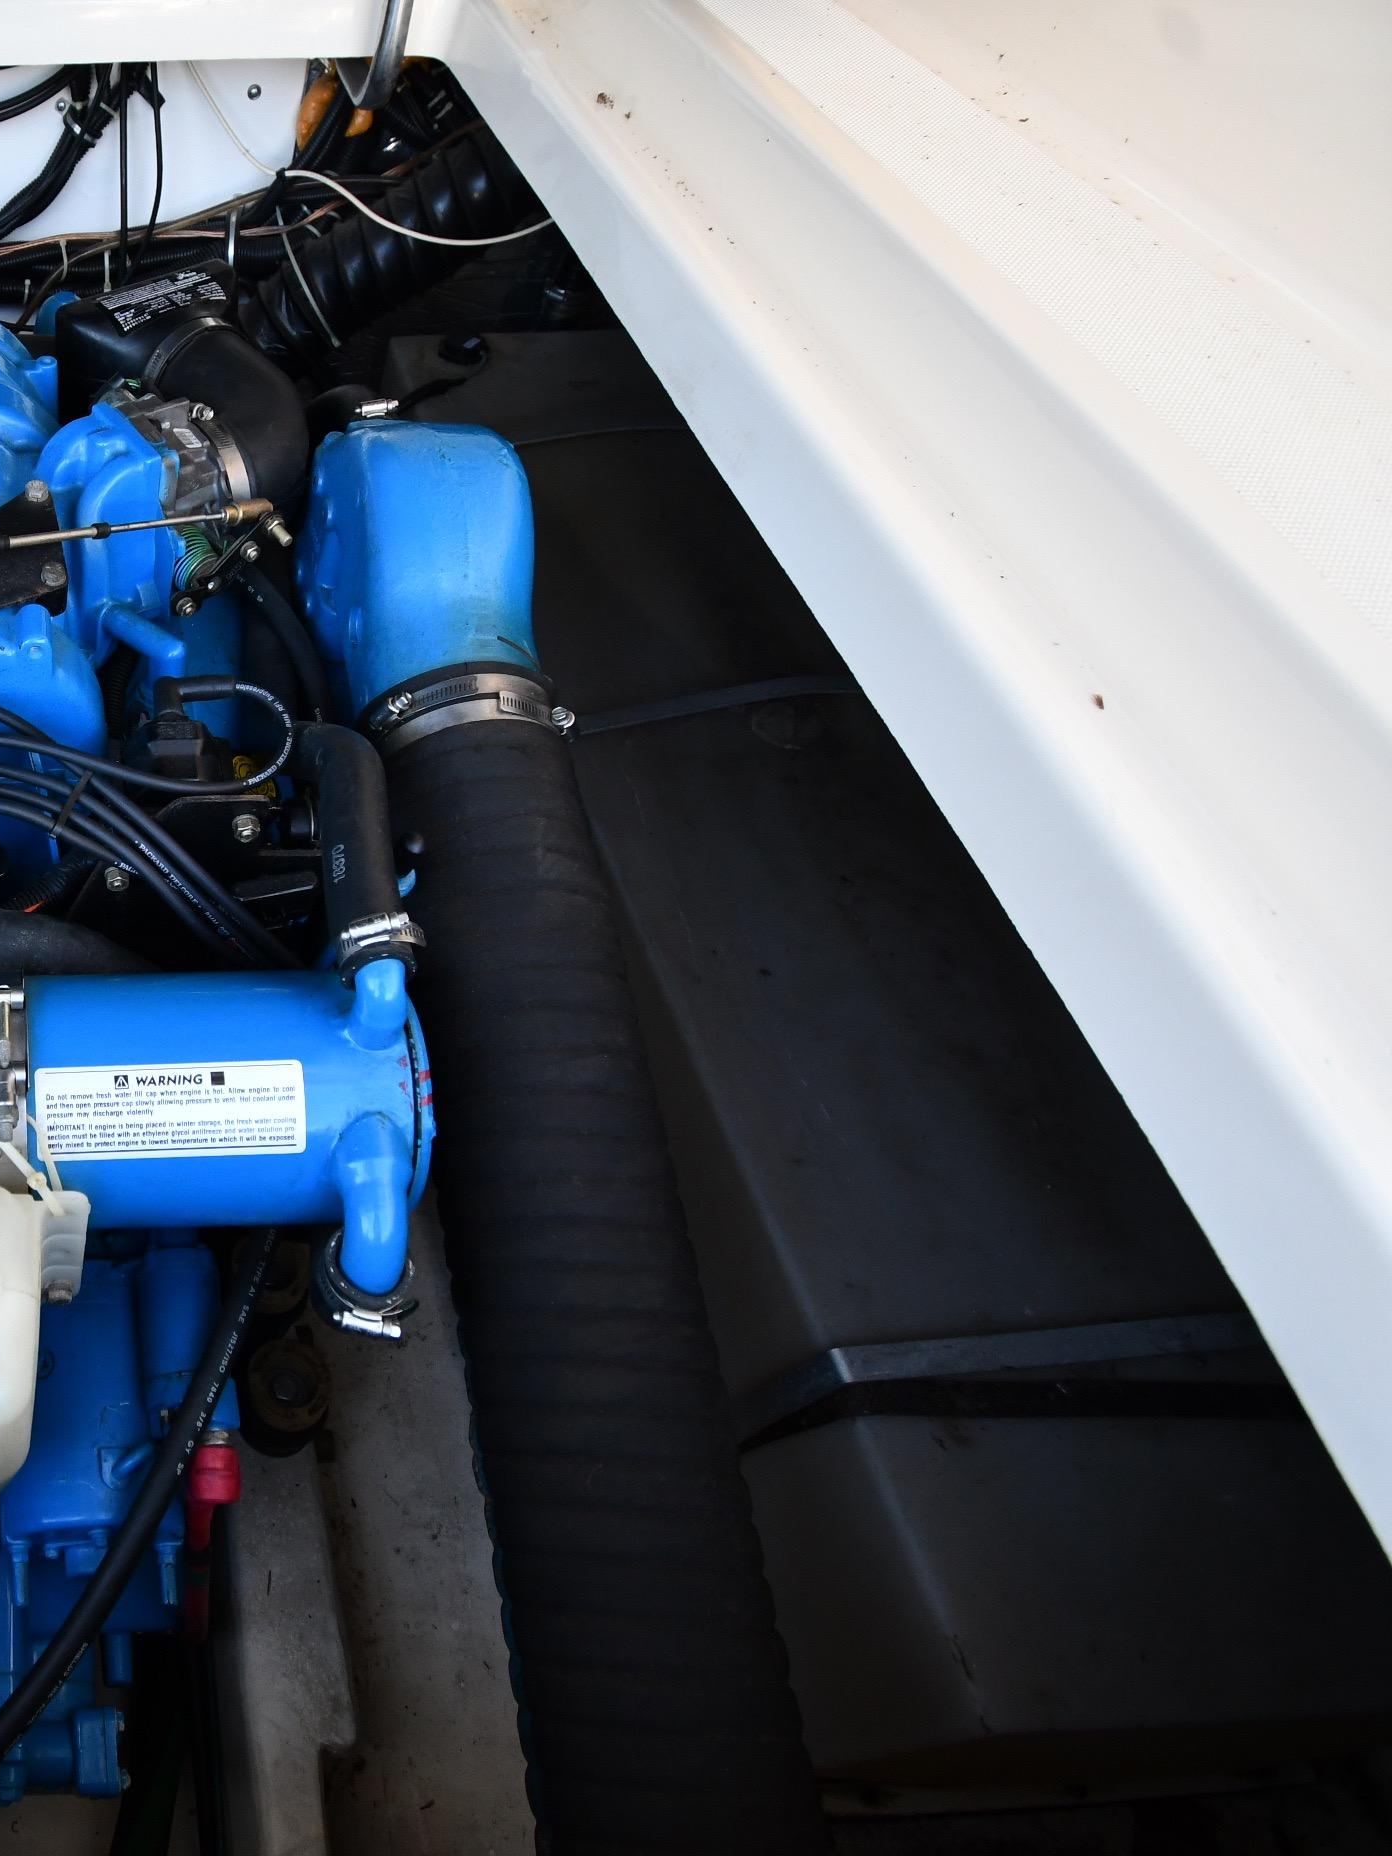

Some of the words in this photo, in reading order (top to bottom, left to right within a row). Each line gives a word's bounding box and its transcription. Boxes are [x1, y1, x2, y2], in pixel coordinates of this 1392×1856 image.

[235, 682, 276, 702] Suppression
[331, 844, 346, 884] 18370
[136, 1074, 203, 1086] WARNING
[46, 1093, 55, 1101] Do
[96, 1091, 113, 1099] fresh
[134, 1090, 143, 1098] fill
[160, 1089, 178, 1097] when
[180, 1088, 201, 1097] engine
[248, 1086, 270, 1095] engine
[46, 1102, 58, 1110] and
[135, 1099, 154, 1108] slowly
[157, 1098, 184, 1107] allowing
[240, 1095, 250, 1103] Hot
[253, 1094, 276, 1102] coolant
[93, 1109, 124, 1118] discharge
[94, 1123, 116, 1131] engine
[126, 1122, 144, 1130] being
[146, 1121, 166, 1129] placed
[274, 1117, 297, 1125] cooling
[142, 1129, 169, 1138] ethylene
[171, 1129, 190, 1137] glycol
[238, 1126, 256, 1134] water
[94, 1139, 116, 1148] protect
[117, 1139, 139, 1147] engine
[171, 1137, 209, 1145] temperature
[238, 1304, 249, 1323] SAE
[206, 1381, 219, 1404] 7840
